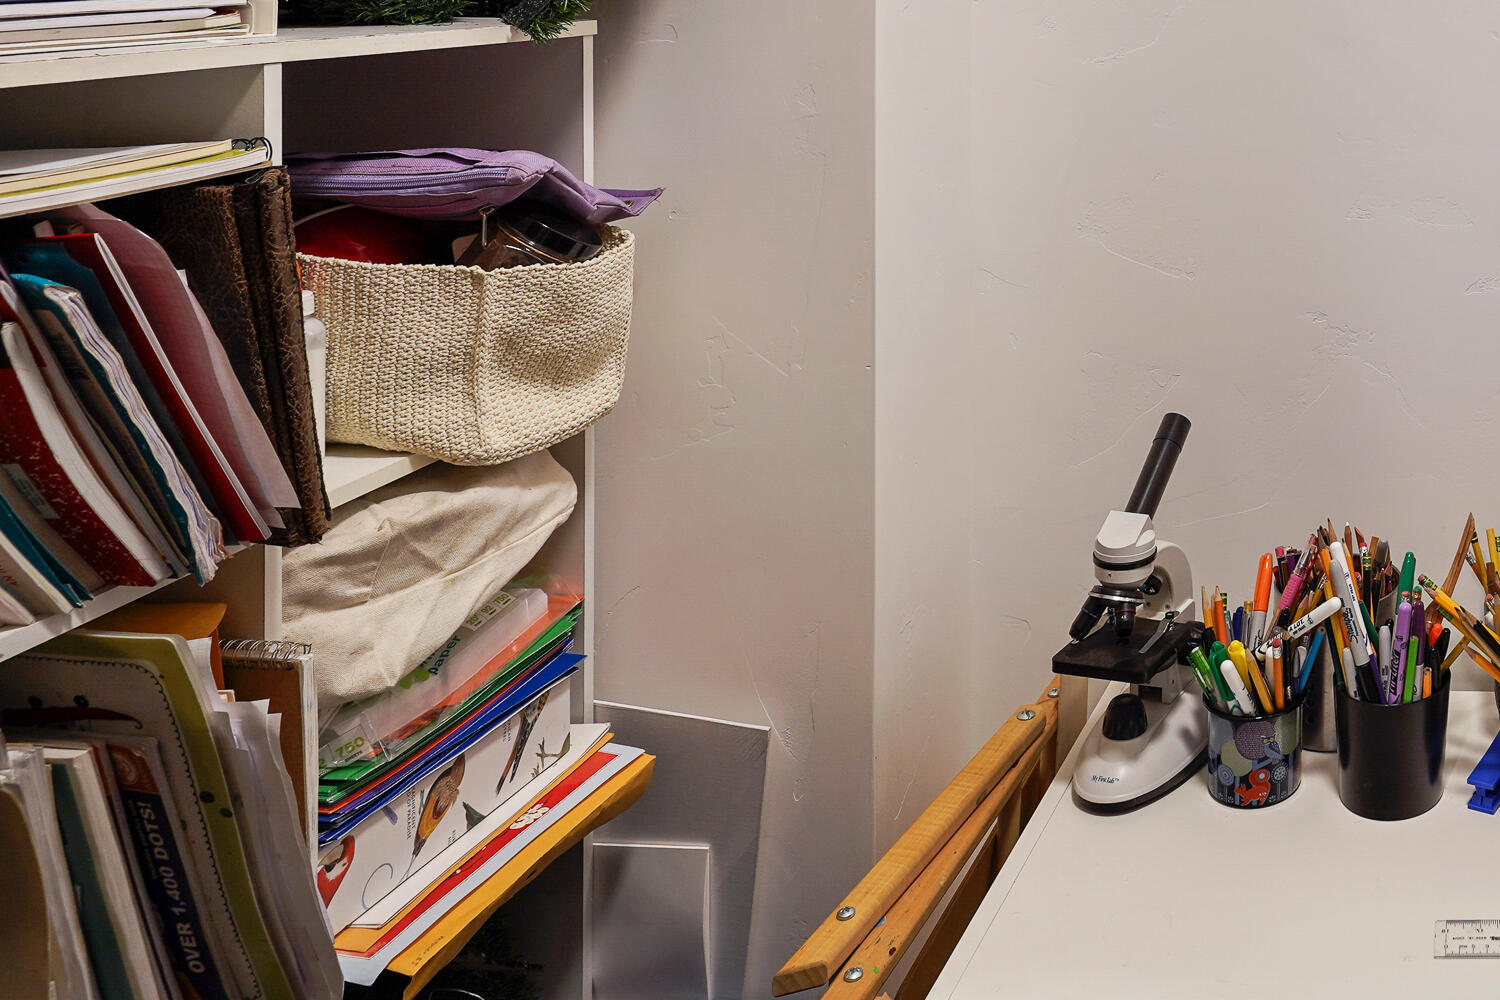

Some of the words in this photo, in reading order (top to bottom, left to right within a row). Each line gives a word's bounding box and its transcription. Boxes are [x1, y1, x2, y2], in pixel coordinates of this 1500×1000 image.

[427, 635, 461, 676] paper
[335, 737, 365, 758] 750
[137, 801, 169, 861] DOTS!
[159, 866, 187, 916] 1,400
[176, 922, 206, 974] OVER
